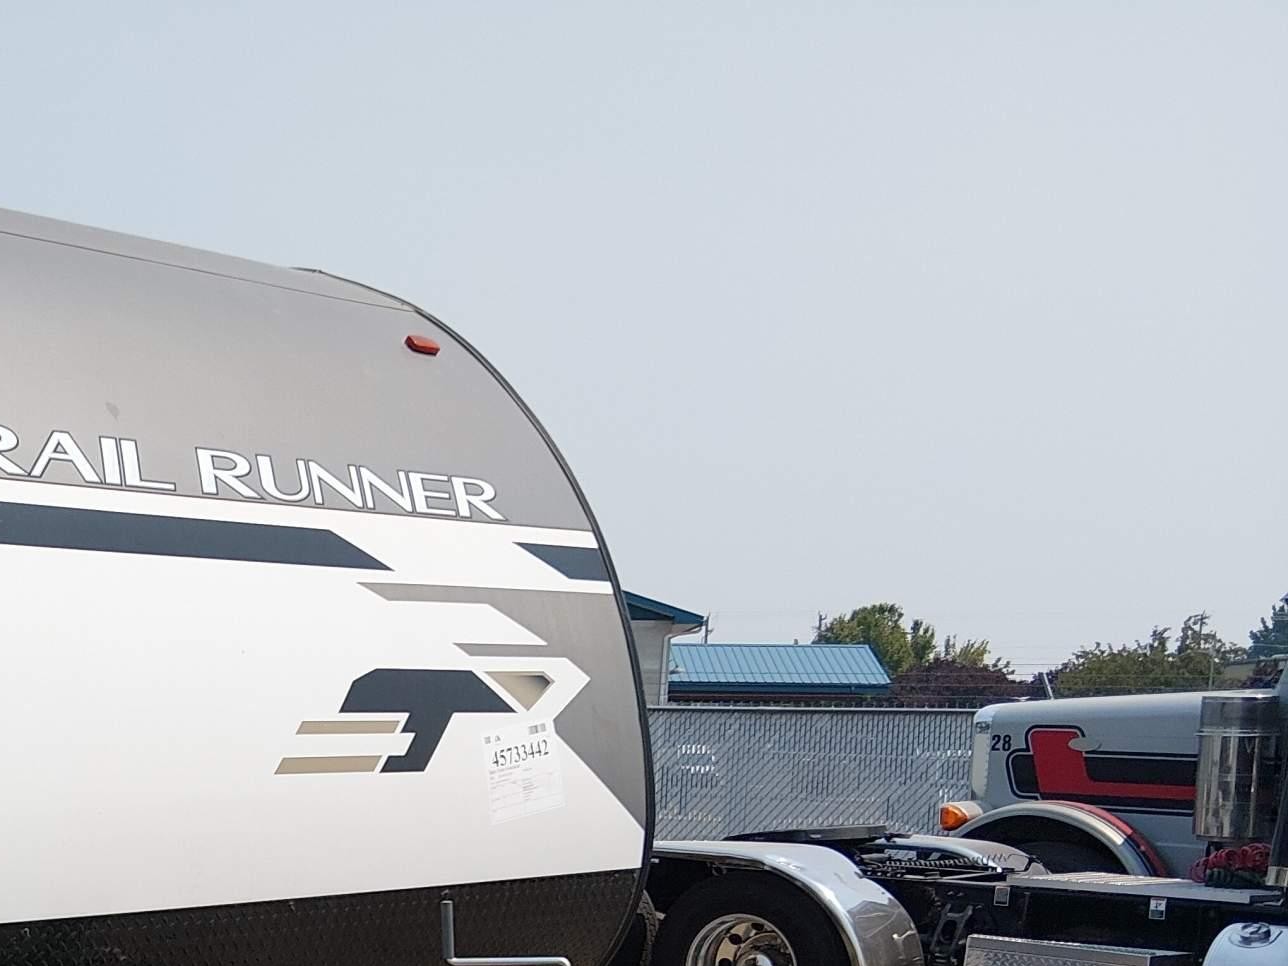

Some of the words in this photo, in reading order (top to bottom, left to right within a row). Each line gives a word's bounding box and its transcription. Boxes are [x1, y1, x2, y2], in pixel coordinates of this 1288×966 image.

[195, 446, 508, 521] RUNNER
[492, 739, 549, 767] 45733442
[991, 734, 1012, 752] 28
